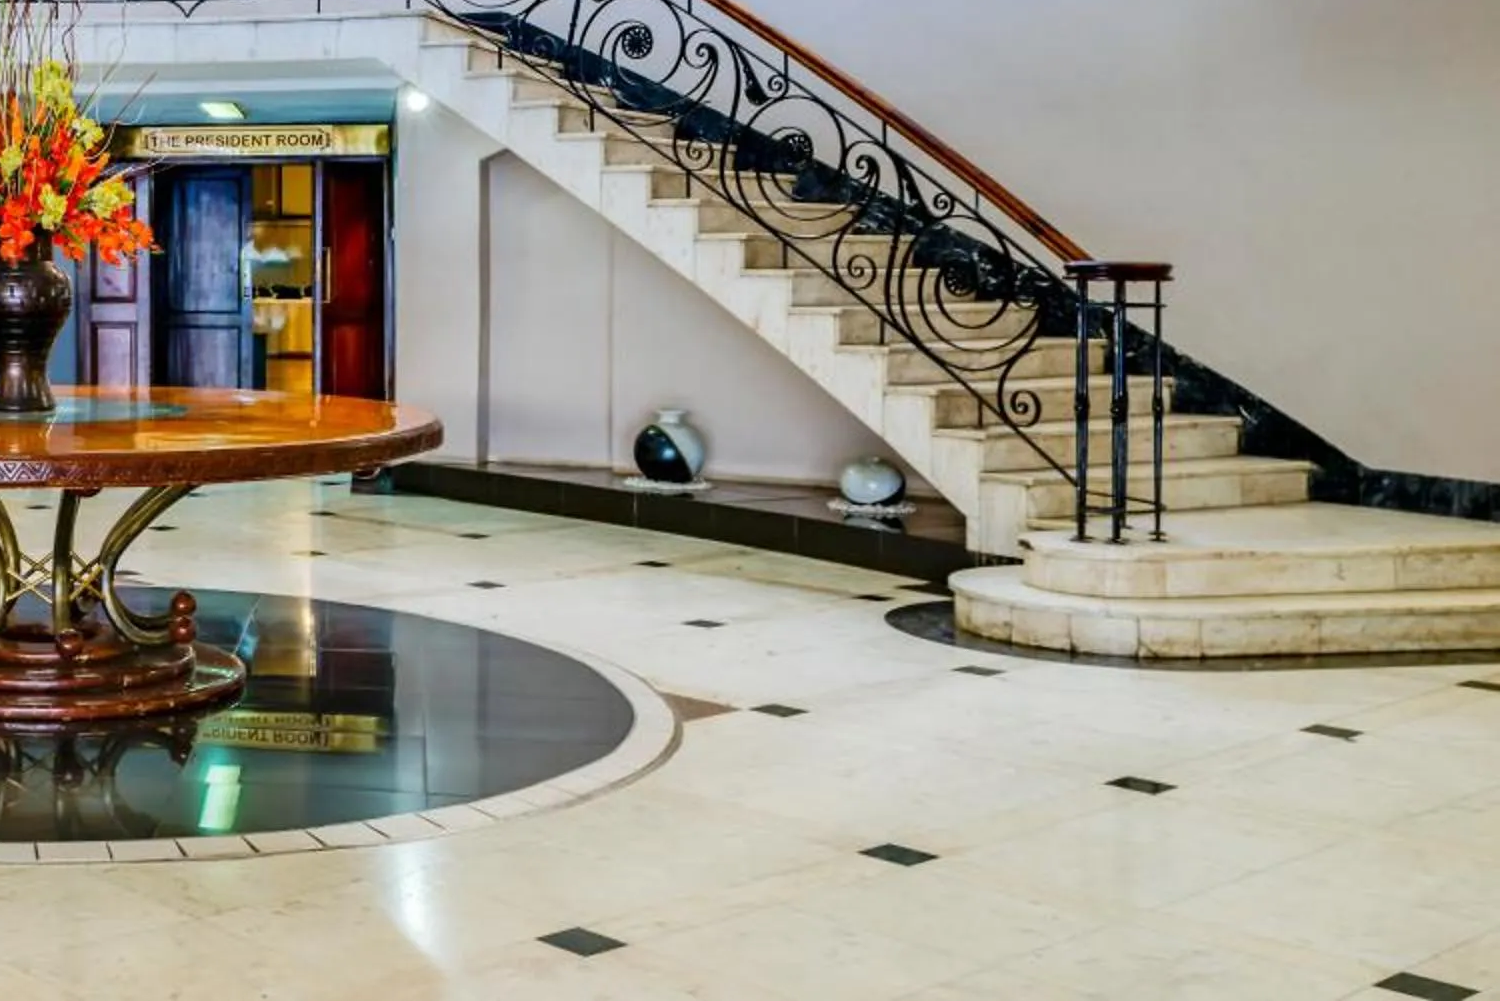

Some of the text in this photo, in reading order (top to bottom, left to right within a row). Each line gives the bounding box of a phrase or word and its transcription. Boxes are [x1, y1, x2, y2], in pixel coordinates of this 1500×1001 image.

[151, 134, 323, 148] THE PRESIDENT ROOM
